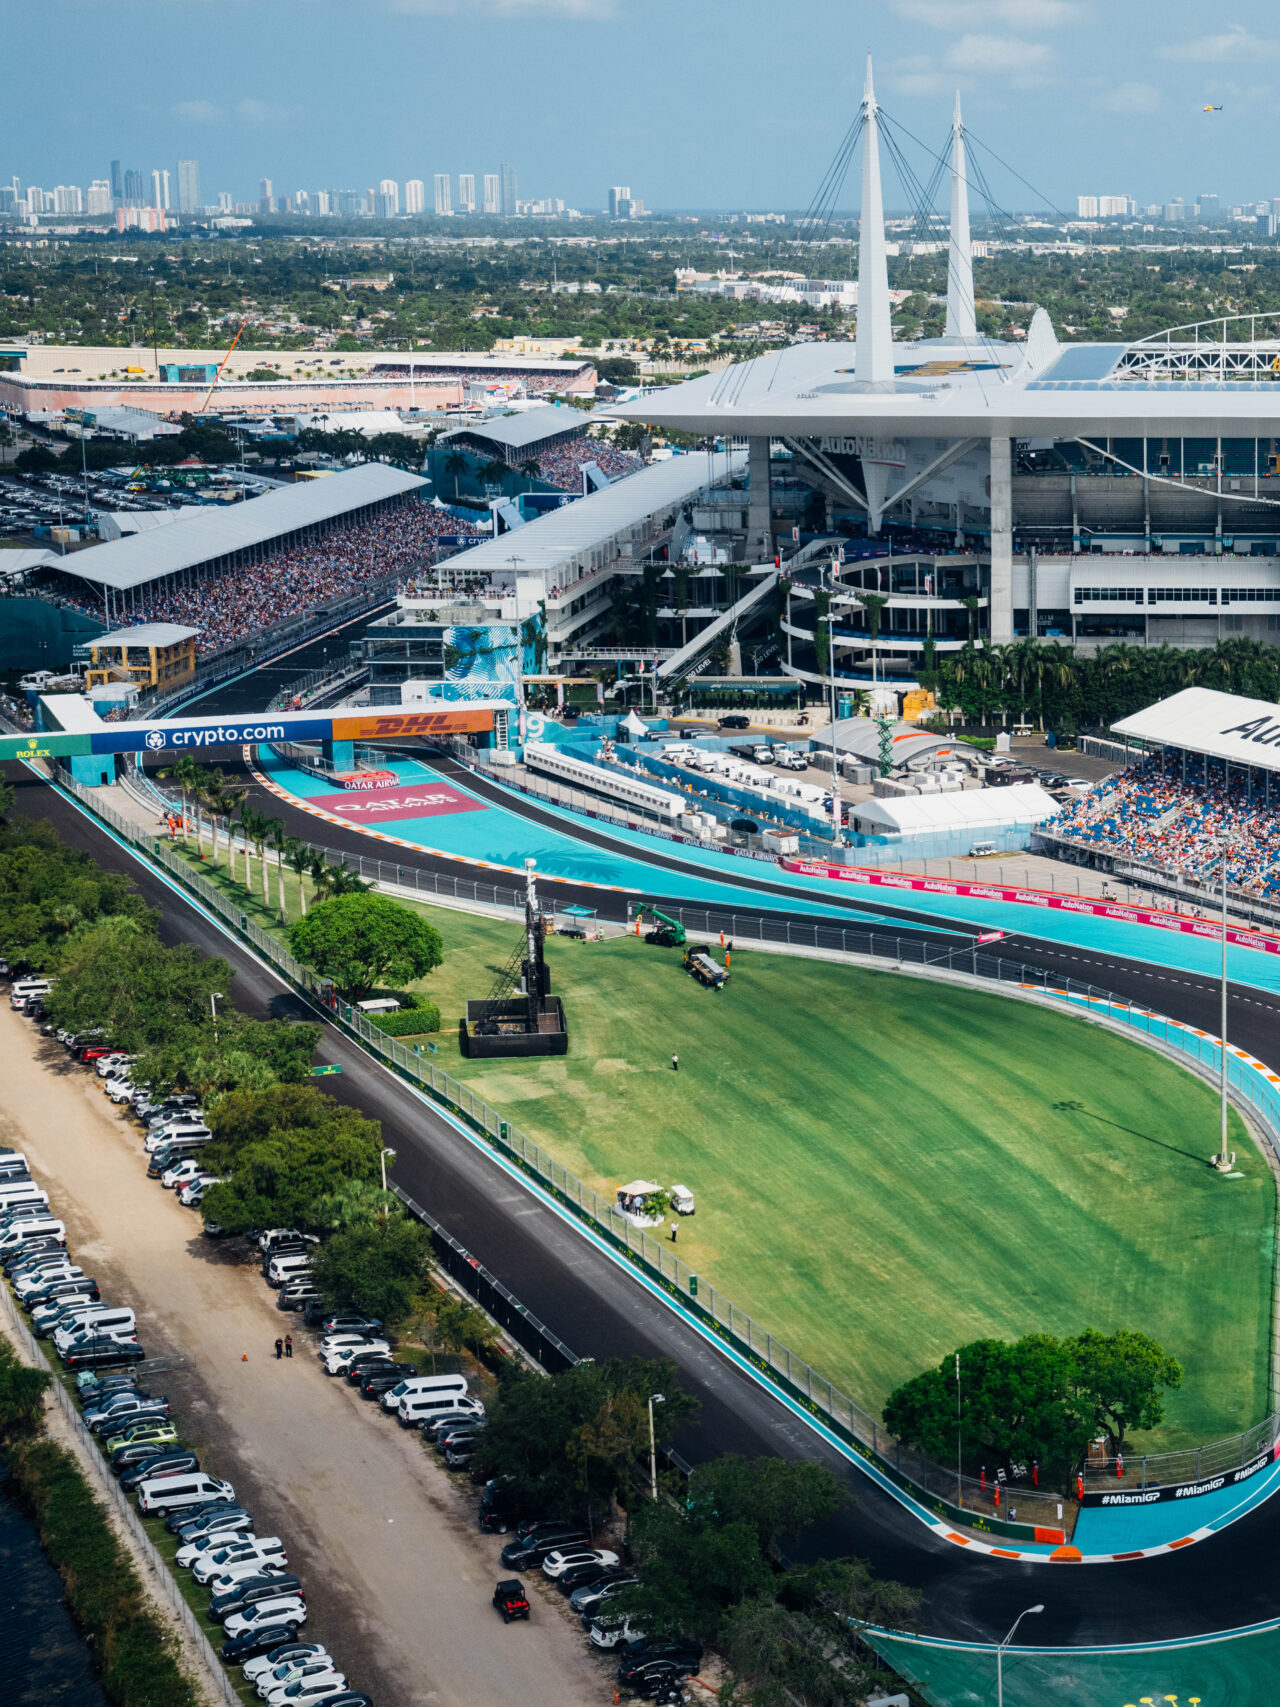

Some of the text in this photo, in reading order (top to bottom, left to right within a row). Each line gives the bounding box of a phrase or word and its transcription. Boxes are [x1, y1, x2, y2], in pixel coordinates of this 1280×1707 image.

[696, 658, 713, 674] LEVEL
[375, 715, 454, 735] DHL
[172, 724, 285, 746] crypto.com
[16, 749, 50, 758] ROLEX
[345, 780, 374, 790] QATAR
[334, 793, 458, 813] QATAR AIRWAYS
[734, 849, 779, 863] QATAR AIRWAYS
[1060, 900, 1093, 911] AutoNation
[1105, 907, 1138, 919] AutoNation
[1149, 916, 1181, 928] AutoNation
[1235, 935, 1265, 948] AutoNation
[1234, 1456, 1268, 1482] #MiamiGP
[1175, 1478, 1225, 1498] #MiamiGP
[1101, 1492, 1160, 1505] #MiamiGP
[972, 1522, 991, 1532] ROLEX
